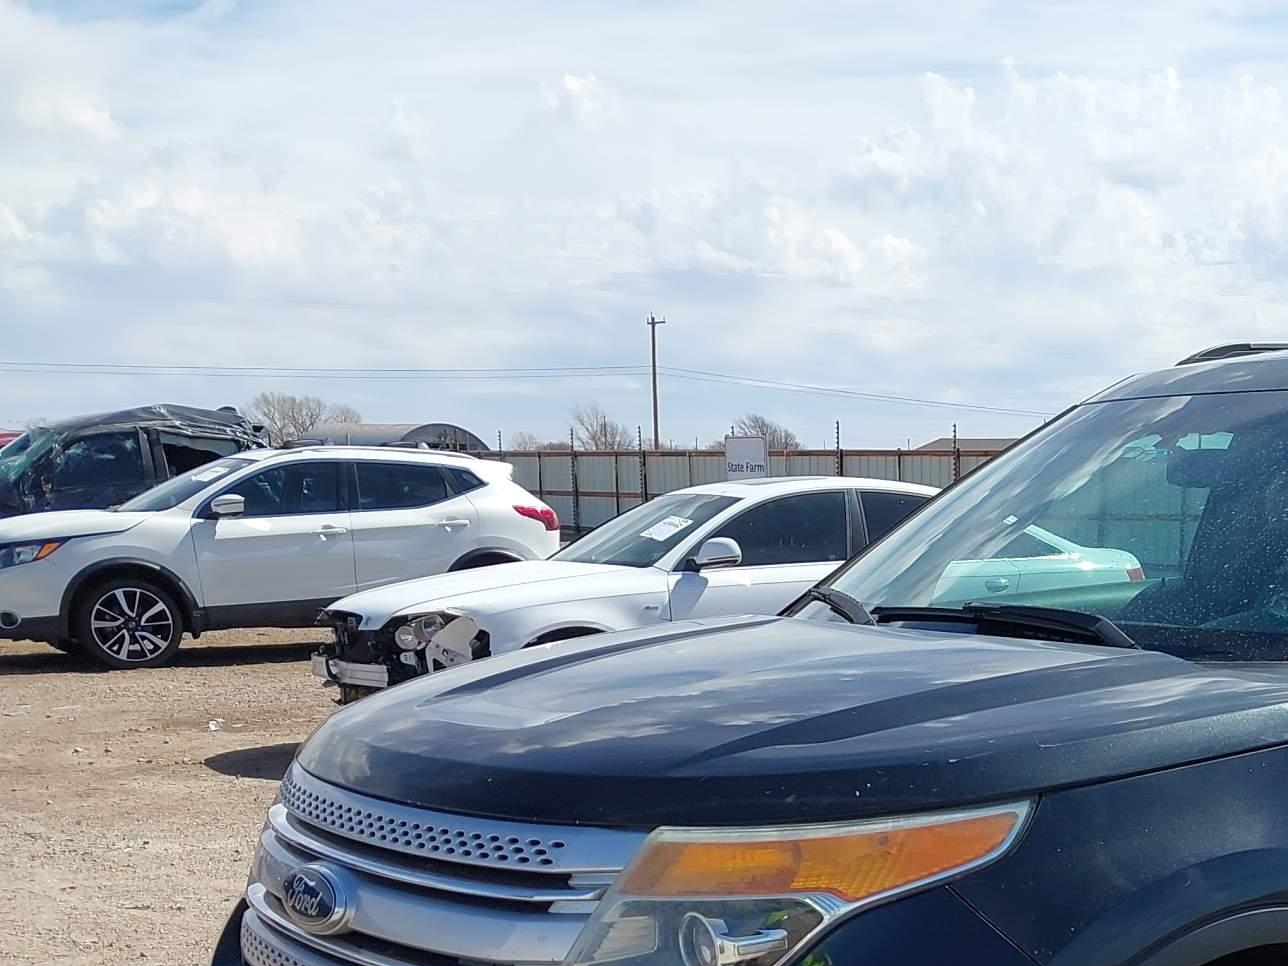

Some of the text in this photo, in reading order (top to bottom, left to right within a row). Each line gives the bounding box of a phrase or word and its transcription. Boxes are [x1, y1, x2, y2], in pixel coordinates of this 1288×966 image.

[727, 461, 765, 473] State Farm
[288, 874, 323, 916] Ford
